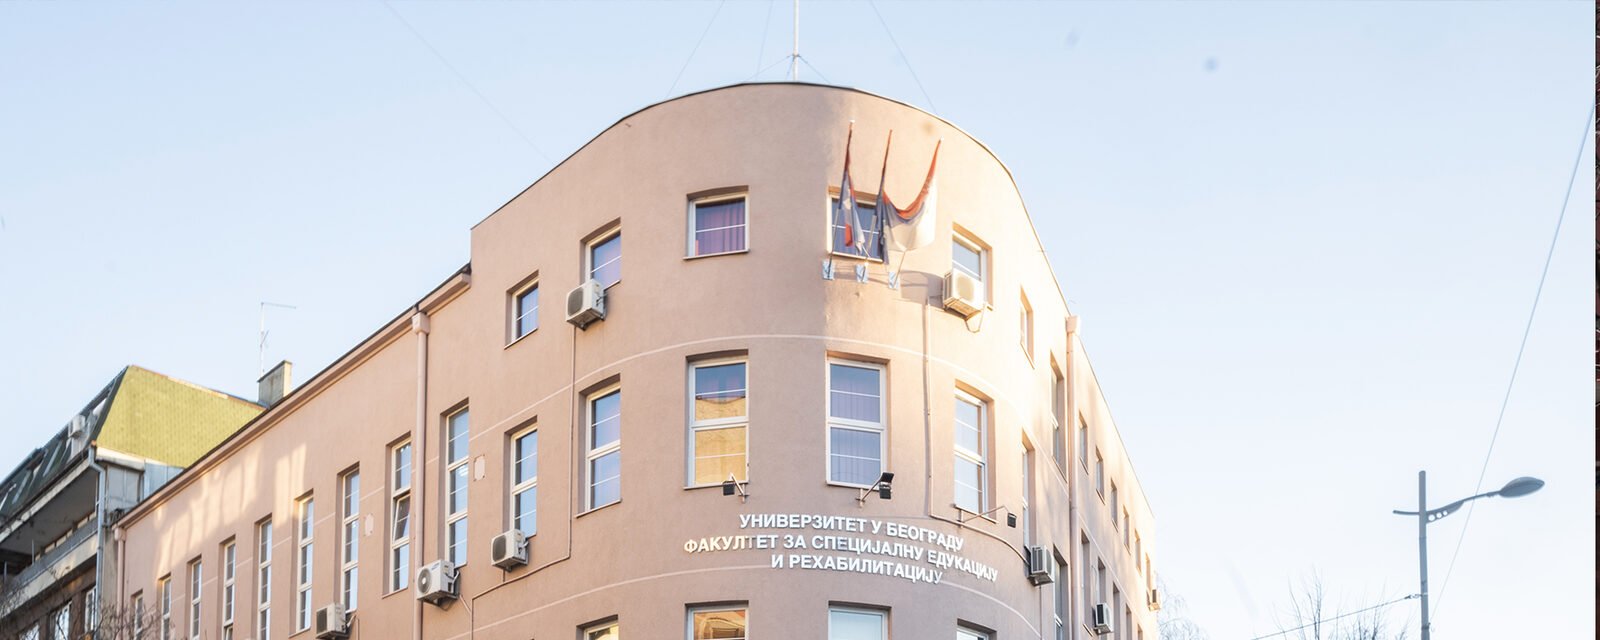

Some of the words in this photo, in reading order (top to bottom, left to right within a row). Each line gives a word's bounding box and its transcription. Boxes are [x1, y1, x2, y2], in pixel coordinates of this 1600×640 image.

[739, 514, 867, 533] УНИВЕРЗИТЕТ
[871, 520, 882, 534] У
[886, 522, 964, 551] БЕОГРАДУ
[684, 535, 779, 553] ФАКУЛТЕТ
[783, 535, 807, 549] ЗА
[811, 535, 924, 561] СПЕЦИЈАЛНУ
[927, 550, 998, 582] ЕДУКАЦИЈУ
[771, 554, 783, 568] И
[789, 554, 943, 584] РЕХАБИЛИТАЦИЈУ
